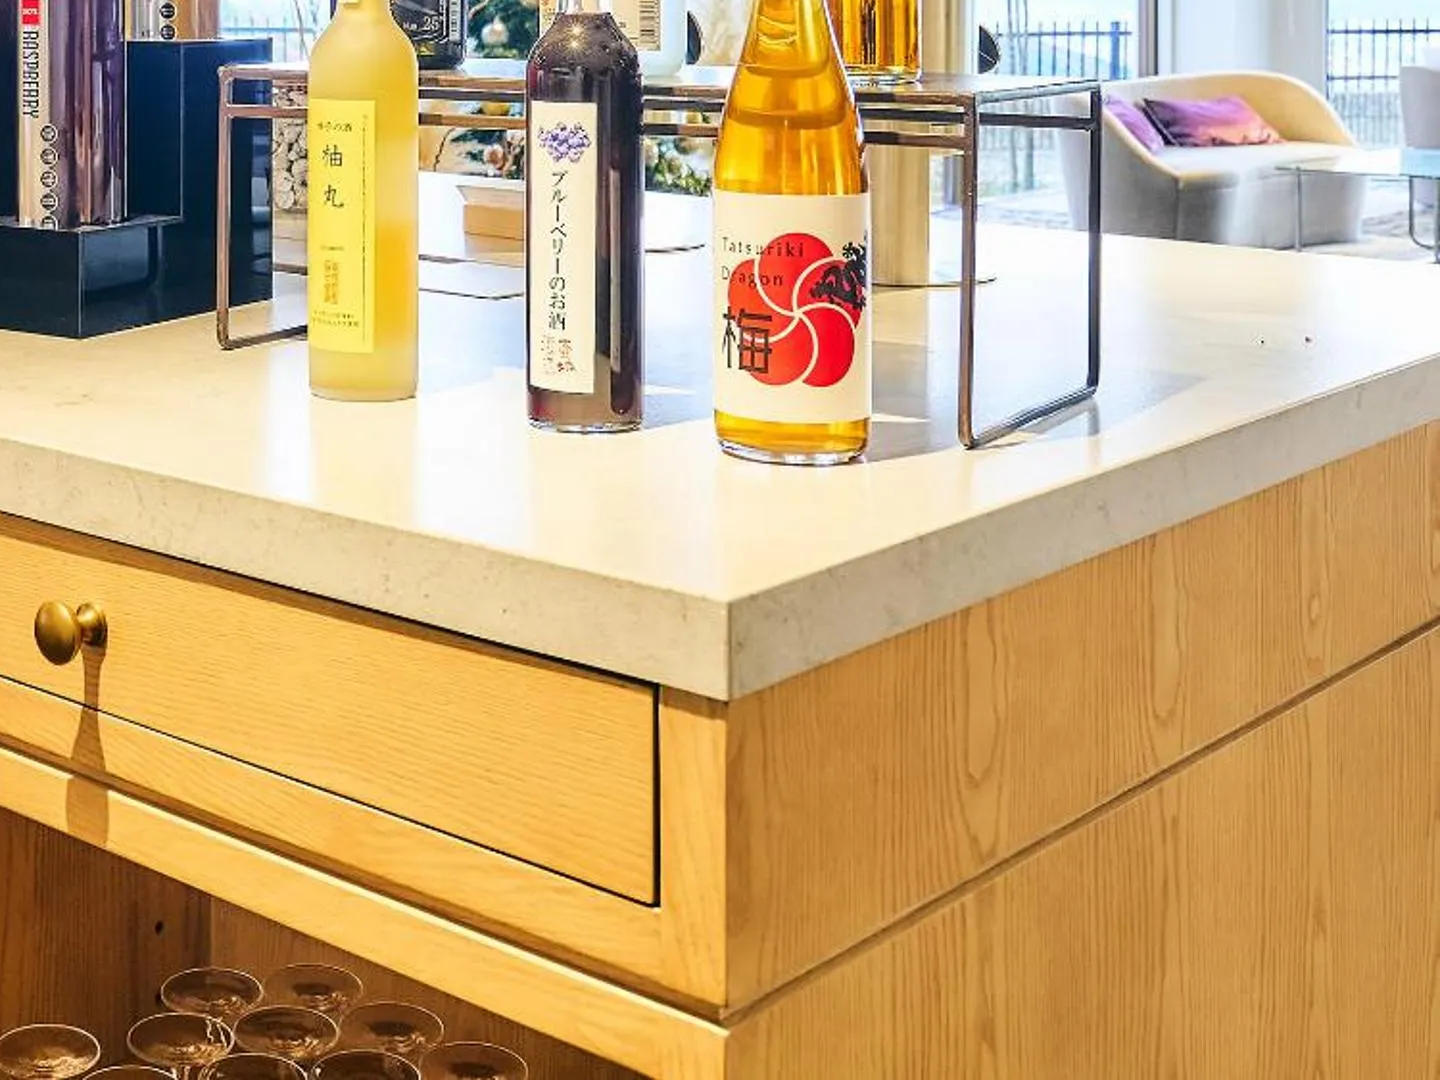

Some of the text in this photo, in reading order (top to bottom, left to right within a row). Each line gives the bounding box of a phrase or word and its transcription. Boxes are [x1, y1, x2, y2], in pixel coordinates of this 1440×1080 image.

[22, 30, 40, 119] RASPBERRY
[549, 170, 569, 331] ブルーベリーのお酒
[721, 266, 784, 288] Dragon
[722, 237, 805, 258] Tatsuriki
[722, 306, 773, 374] 梅
